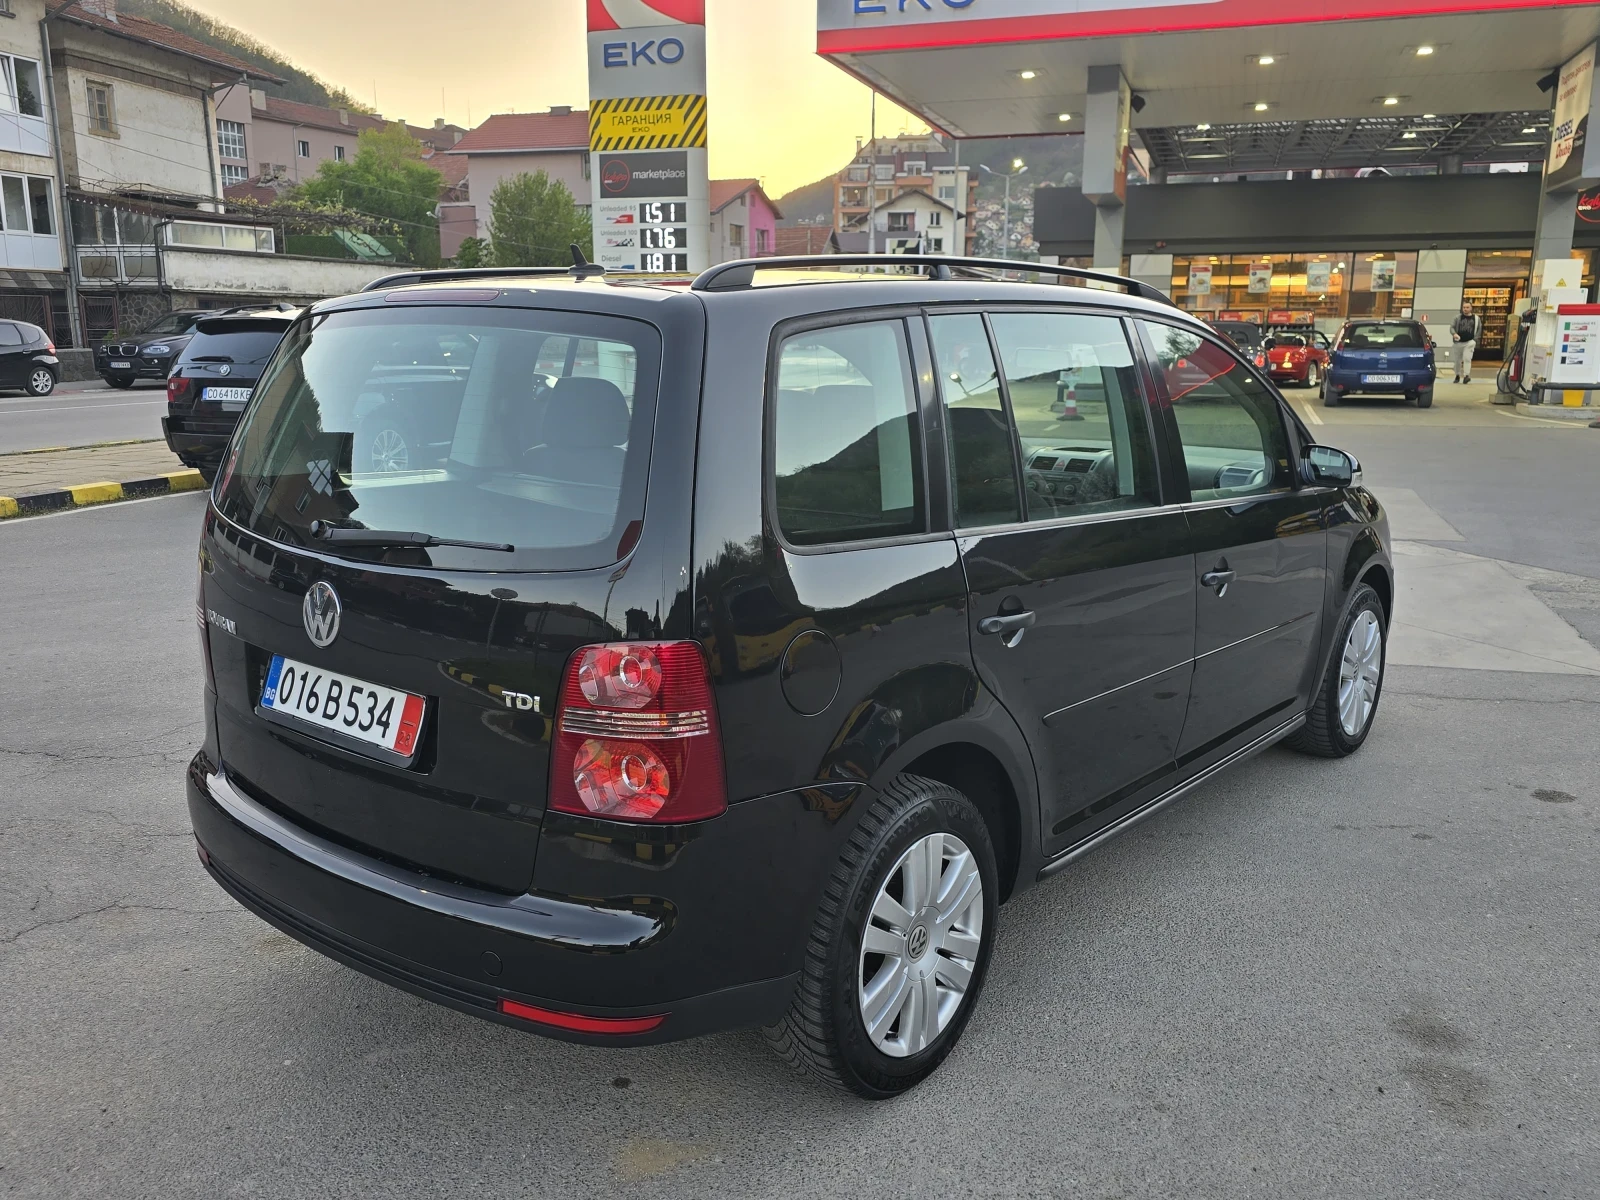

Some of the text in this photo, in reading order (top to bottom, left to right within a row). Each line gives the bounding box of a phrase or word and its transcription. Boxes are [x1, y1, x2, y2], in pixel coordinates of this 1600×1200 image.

[603, 38, 684, 68] EKO
[612, 113, 671, 126] ГАРАНЦИЯ
[632, 168, 686, 180] marketplace
[646, 227, 676, 249] 1.76
[601, 254, 621, 262] Diesel
[264, 686, 276, 701] BG
[279, 666, 396, 738] 016B534
[501, 690, 541, 713] TDI
